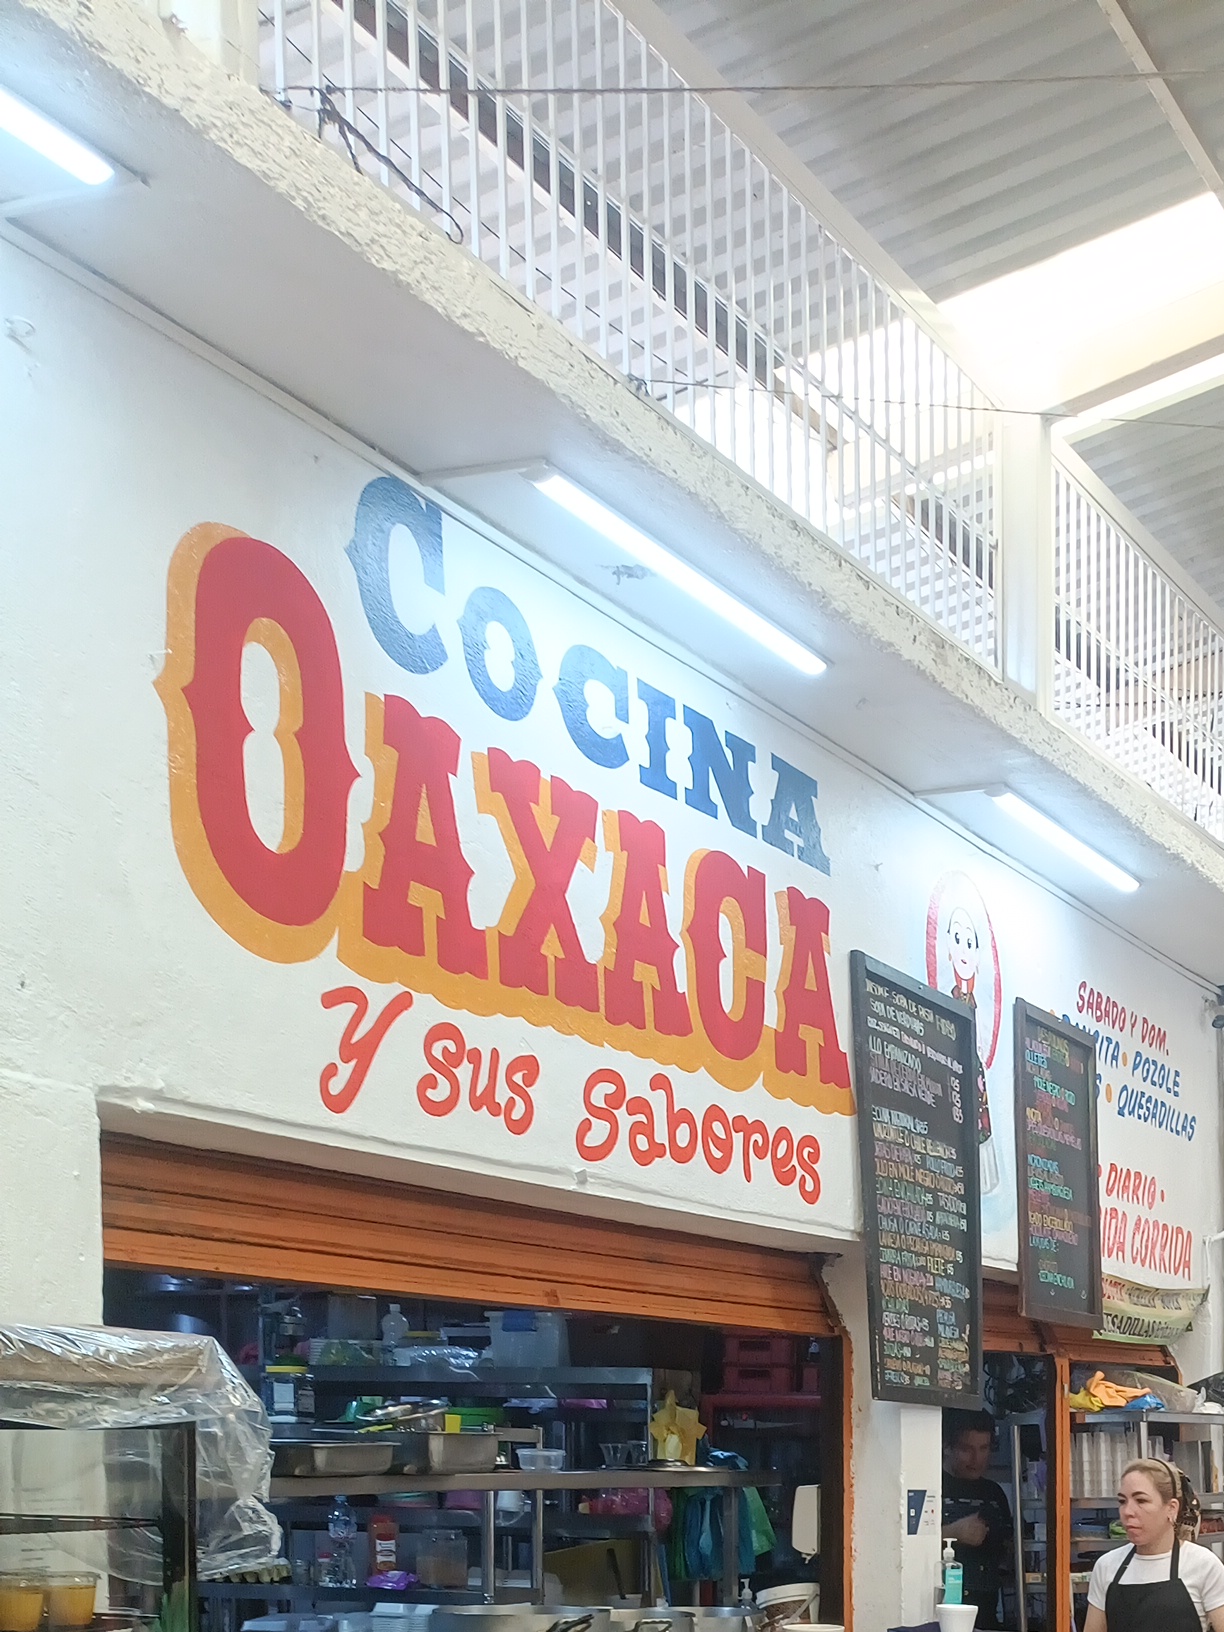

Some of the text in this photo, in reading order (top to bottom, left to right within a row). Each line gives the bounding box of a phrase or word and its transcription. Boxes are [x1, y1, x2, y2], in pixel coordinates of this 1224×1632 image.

[345, 476, 830, 876] COCINA
[152, 522, 857, 1115] OAXACA
[320, 985, 413, 1114] Y
[1077, 981, 1169, 1056] SABADO Y DOM.
[1132, 1051, 1180, 1097] POZOLE
[1117, 1084, 1197, 1141] QUESADILLAS
[1106, 1163, 1157, 1210] DIARIO
[1131, 1215, 1193, 1281] CORRIDA
